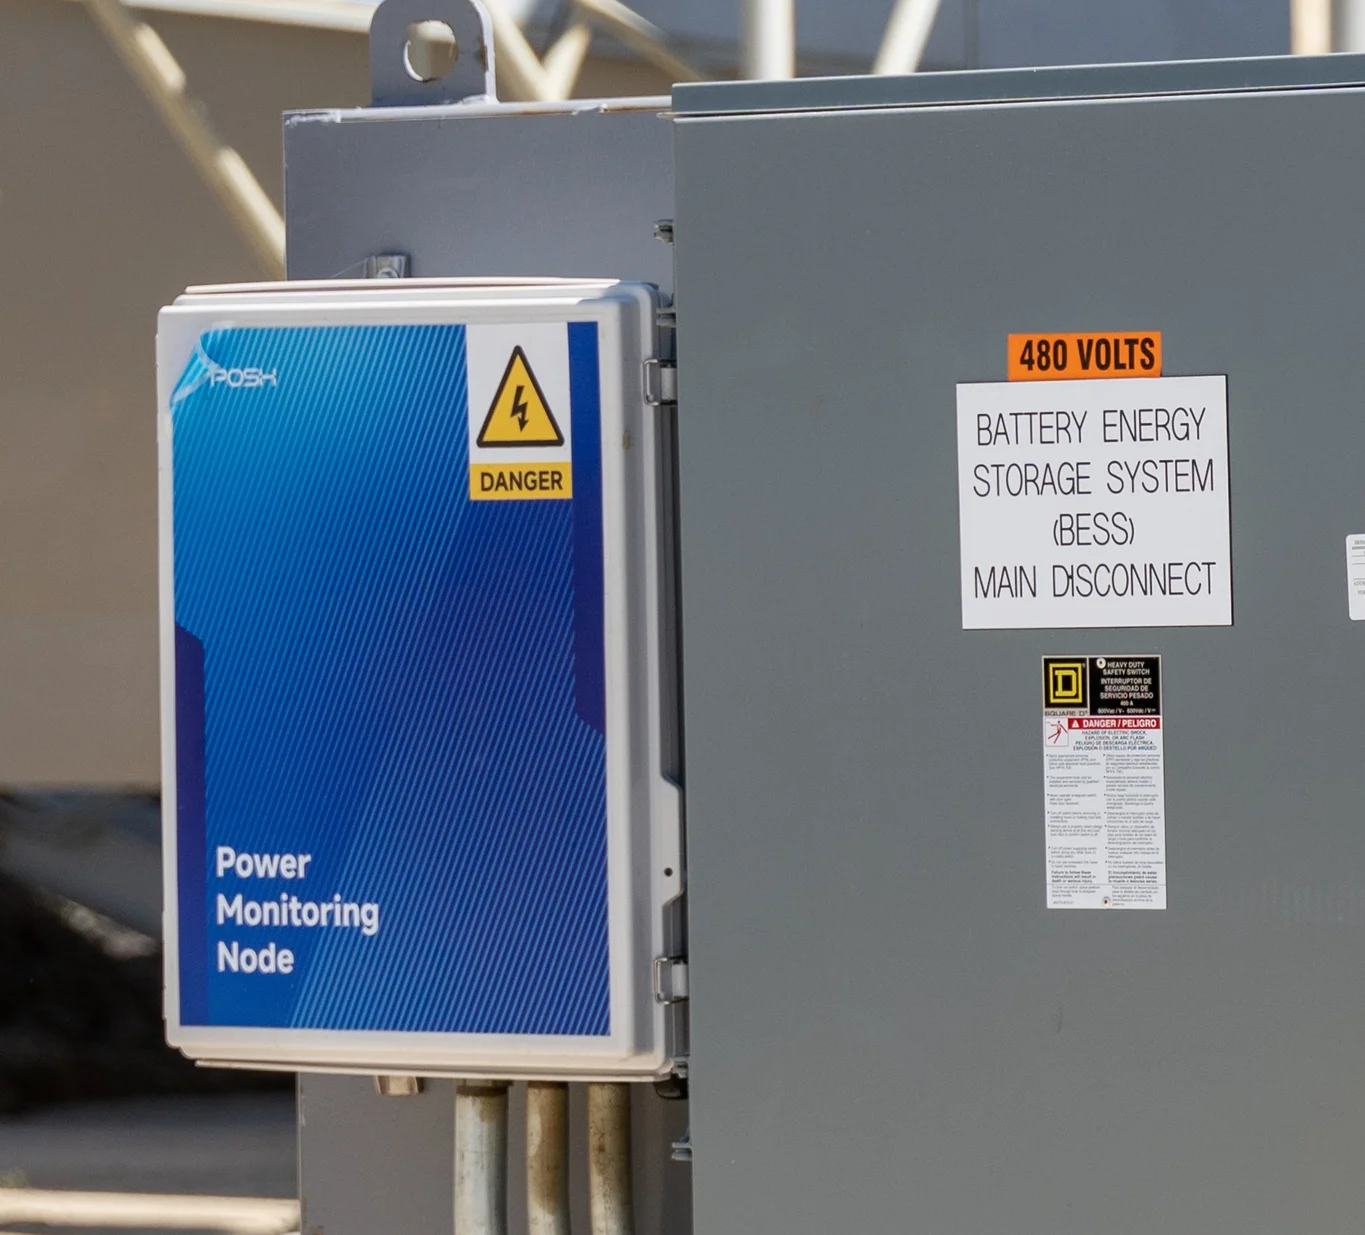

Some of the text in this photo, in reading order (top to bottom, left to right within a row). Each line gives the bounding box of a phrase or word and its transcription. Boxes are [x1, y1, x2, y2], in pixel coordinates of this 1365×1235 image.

[1019, 337, 1155, 372] 480 VOLTS
[209, 366, 278, 388] POSH
[976, 406, 1207, 447] BATTERY ENERGY
[479, 469, 564, 494] DANGER
[972, 458, 1215, 498] STORAGE SYSTEM
[1053, 511, 1136, 547] (BESS)
[974, 561, 1217, 599] MAIN DISCONNECT
[216, 846, 311, 880] Power
[216, 893, 380, 936] Monitoring
[217, 941, 294, 974] Node
